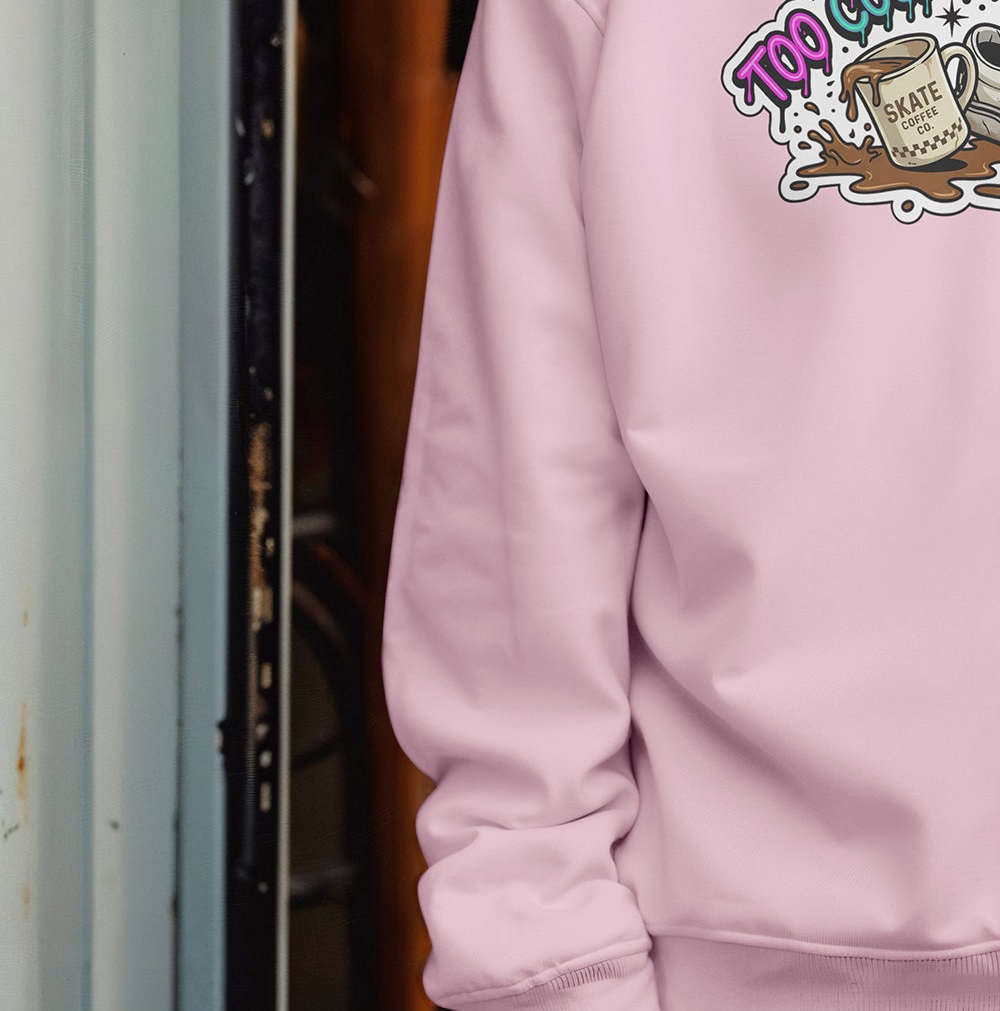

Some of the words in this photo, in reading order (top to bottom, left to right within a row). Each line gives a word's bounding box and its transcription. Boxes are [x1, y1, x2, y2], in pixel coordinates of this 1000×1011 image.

[735, 10, 831, 103] TOO
[884, 81, 942, 123] SKATE
[901, 106, 938, 130] COFFEE
[917, 124, 934, 135] CO.
